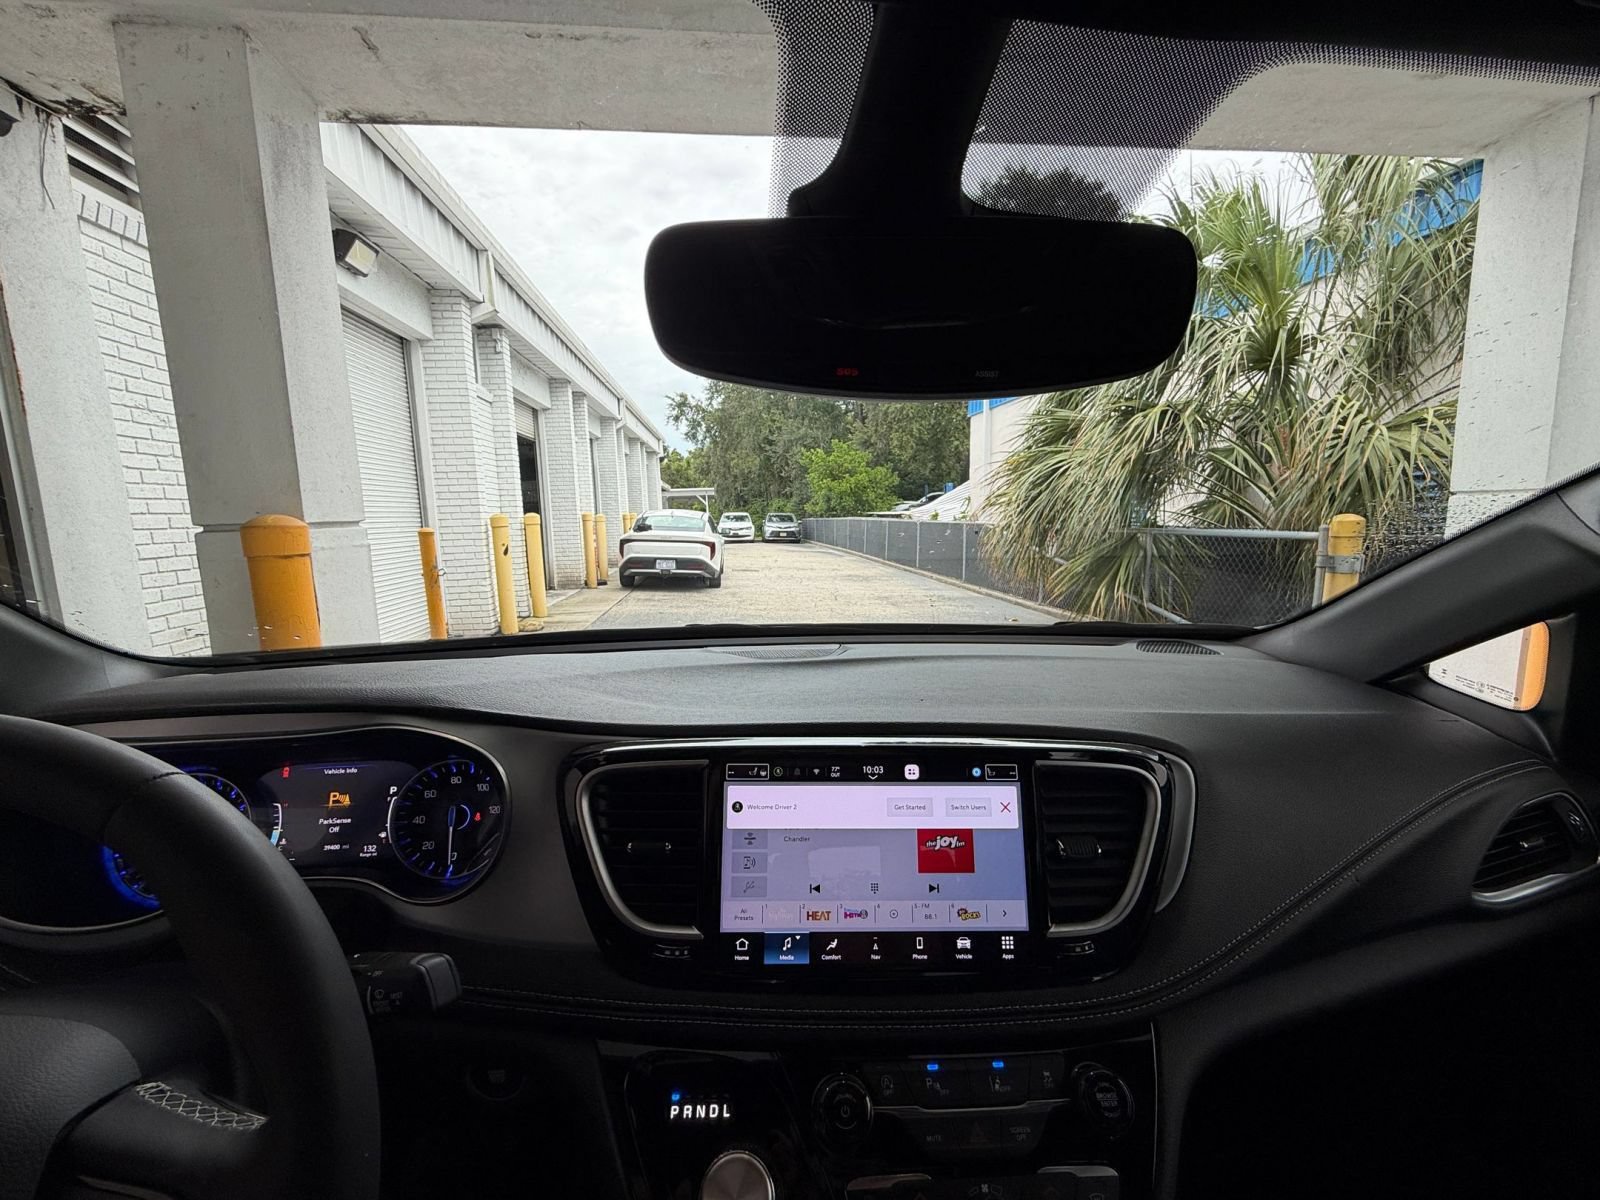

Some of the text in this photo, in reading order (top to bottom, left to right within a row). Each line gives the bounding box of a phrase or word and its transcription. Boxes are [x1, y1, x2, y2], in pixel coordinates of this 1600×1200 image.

[390, 786, 398, 794] P
[424, 790, 436, 798] 60
[489, 806, 500, 814] 120
[412, 816, 425, 824] 40
[422, 841, 434, 850] 20
[806, 911, 831, 920] HEAT
